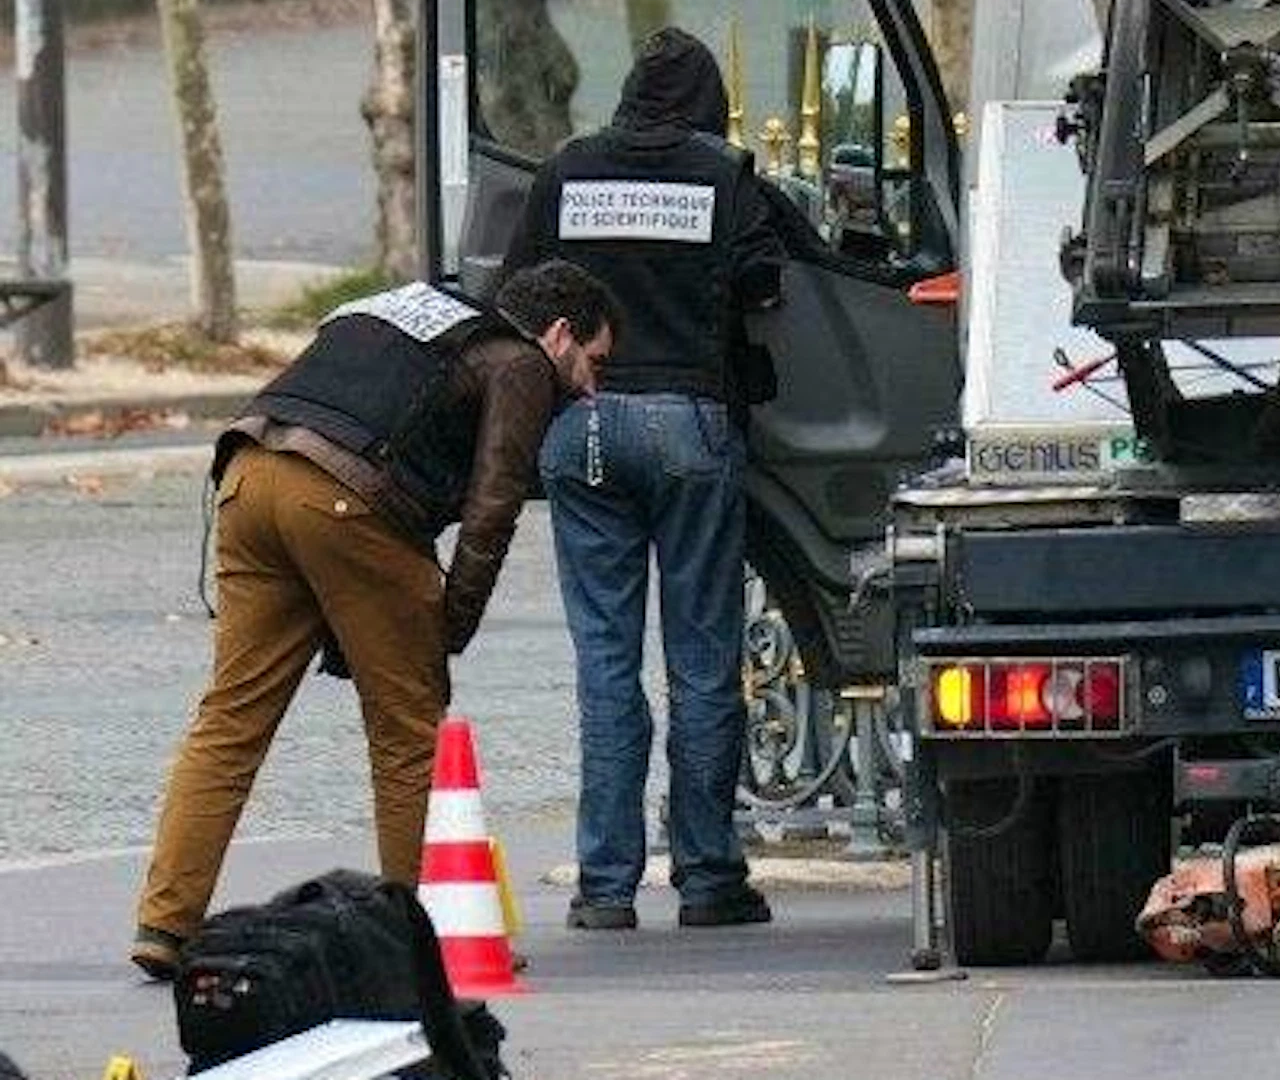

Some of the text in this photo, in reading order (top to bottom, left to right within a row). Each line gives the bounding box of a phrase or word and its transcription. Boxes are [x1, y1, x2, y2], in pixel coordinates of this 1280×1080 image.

[564, 192, 713, 210] POLICE TECHNIQUE
[570, 212, 699, 229] ET SCIENTIFIQUE
